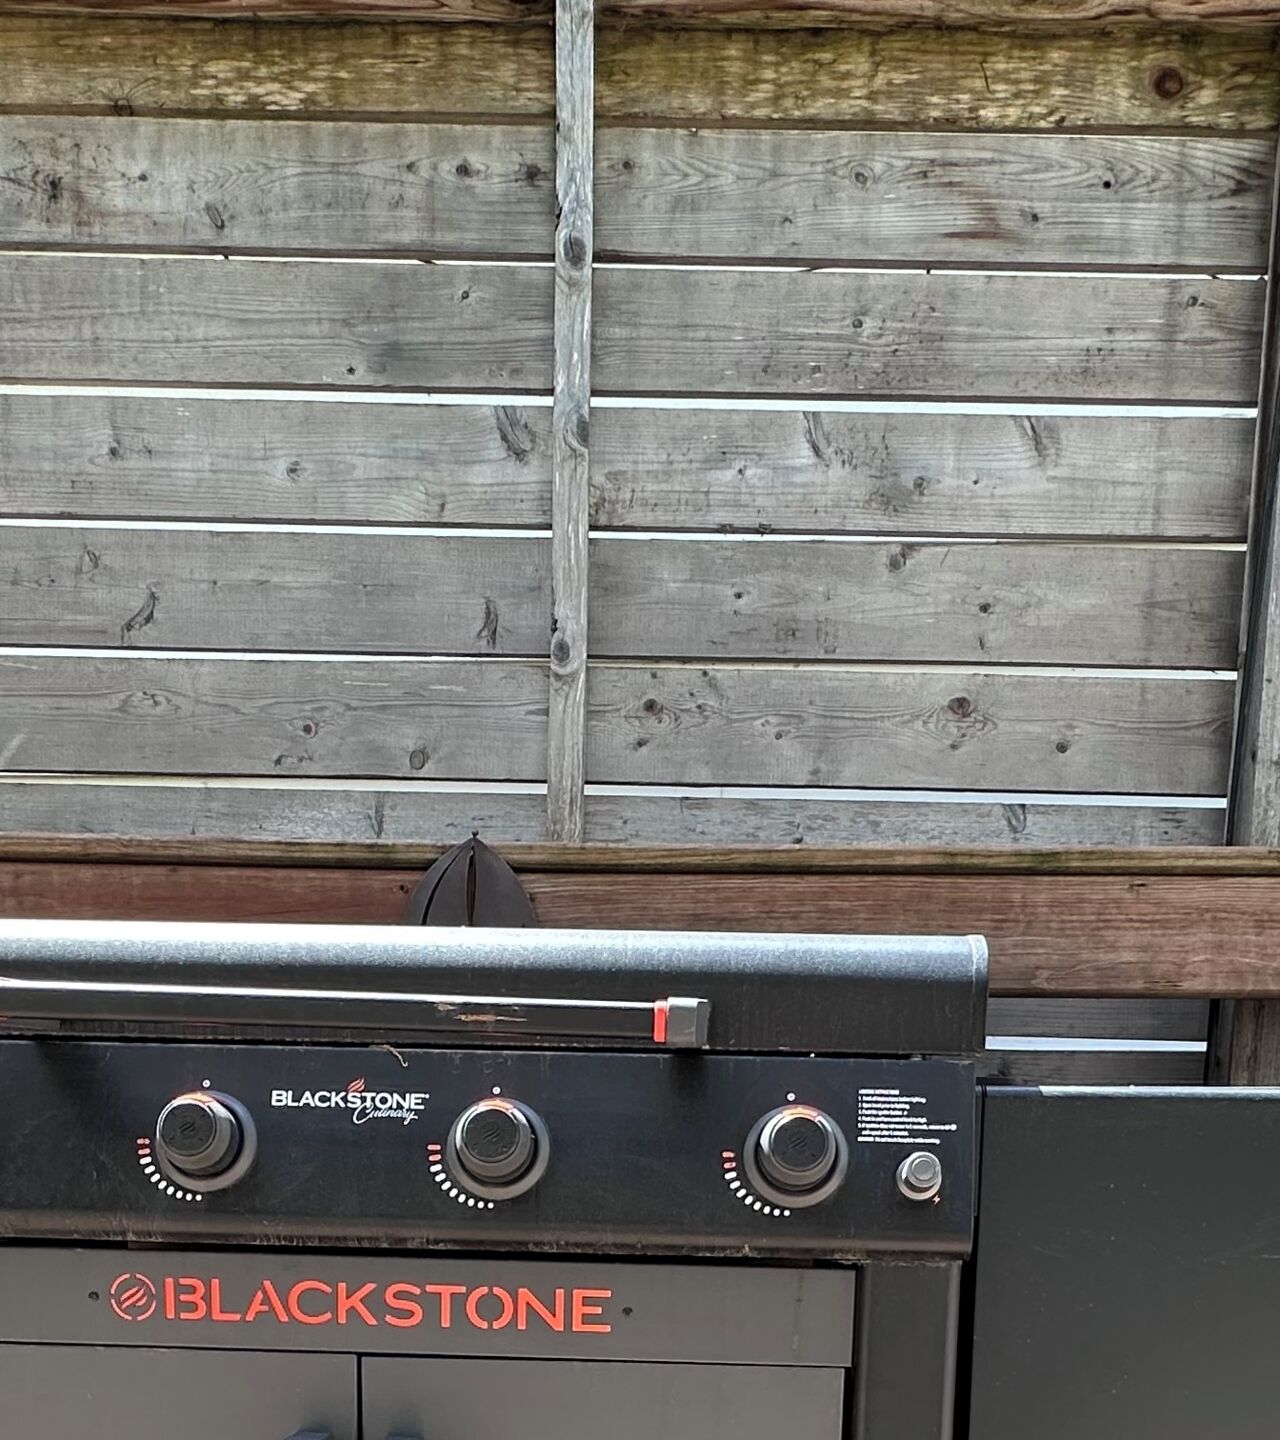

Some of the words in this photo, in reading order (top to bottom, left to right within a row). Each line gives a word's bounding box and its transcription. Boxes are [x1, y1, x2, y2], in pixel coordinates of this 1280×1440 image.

[271, 1090, 426, 1109] BLACKSTONE
[353, 1101, 419, 1124] Culinary
[164, 1276, 612, 1333] BLACKSTONE
